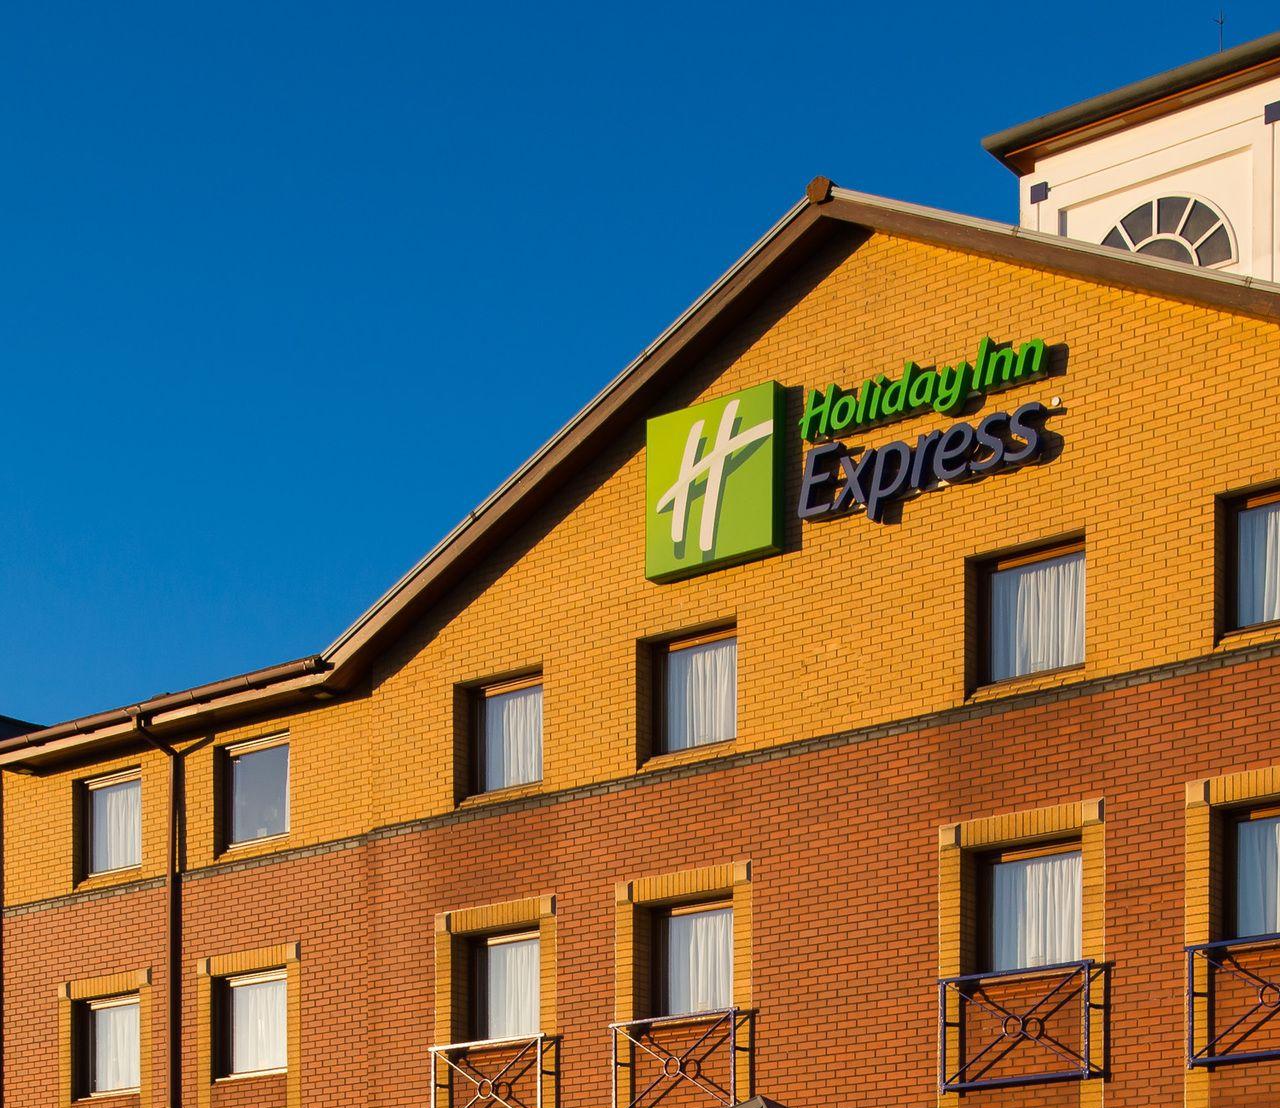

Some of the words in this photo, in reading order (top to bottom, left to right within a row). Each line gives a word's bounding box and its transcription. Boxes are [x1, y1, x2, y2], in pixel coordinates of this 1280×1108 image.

[799, 360, 972, 442] Holiday
[972, 336, 1048, 392] Inn
[797, 402, 1046, 524] Express
